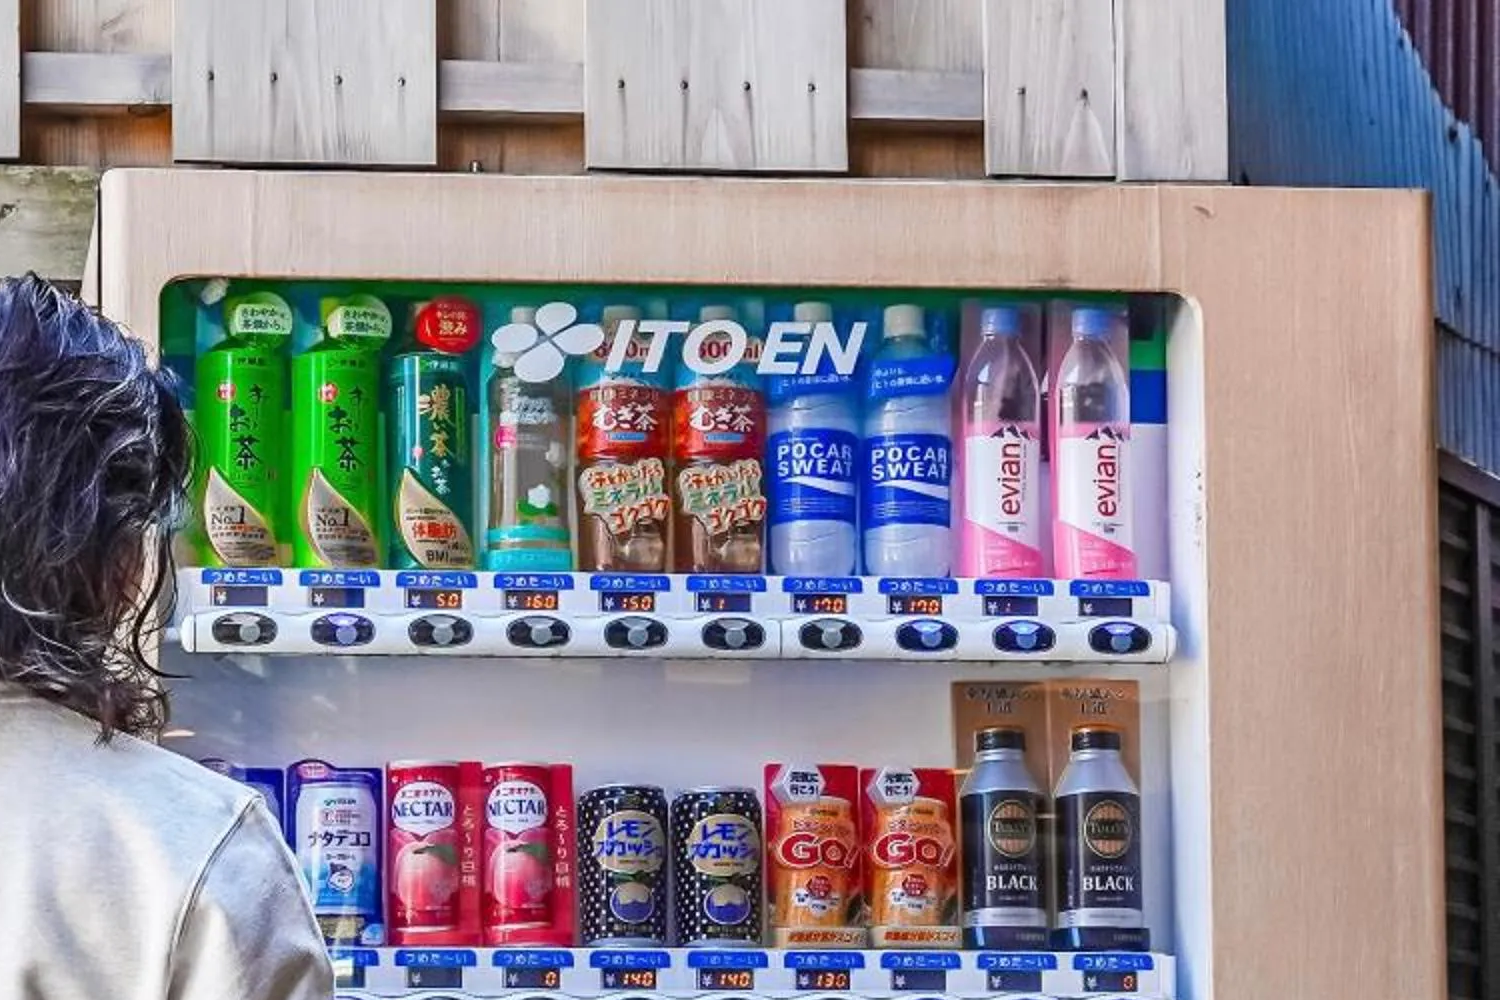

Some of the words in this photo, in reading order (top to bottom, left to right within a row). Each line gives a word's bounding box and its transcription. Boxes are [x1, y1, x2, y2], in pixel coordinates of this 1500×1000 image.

[592, 402, 659, 432] むぎ茶
[689, 403, 755, 433] むぎ茶
[229, 404, 264, 472] お茶
[328, 405, 366, 473] お茶
[777, 459, 852, 478] SWEAT
[871, 462, 947, 481] SWEAT
[997, 441, 1021, 515] evian
[1093, 443, 1117, 516] evian
[211, 505, 245, 525] No.1
[315, 507, 350, 527] No.1
[425, 549, 450, 563] BMI
[307, 830, 371, 847] ナタデココ
[606, 818, 657, 839] レモン
[701, 822, 748, 842] レモン
[779, 831, 860, 869] GO!
[873, 831, 955, 869] GO!
[986, 874, 1038, 891] BLACK
[1082, 875, 1134, 891] BLACK
